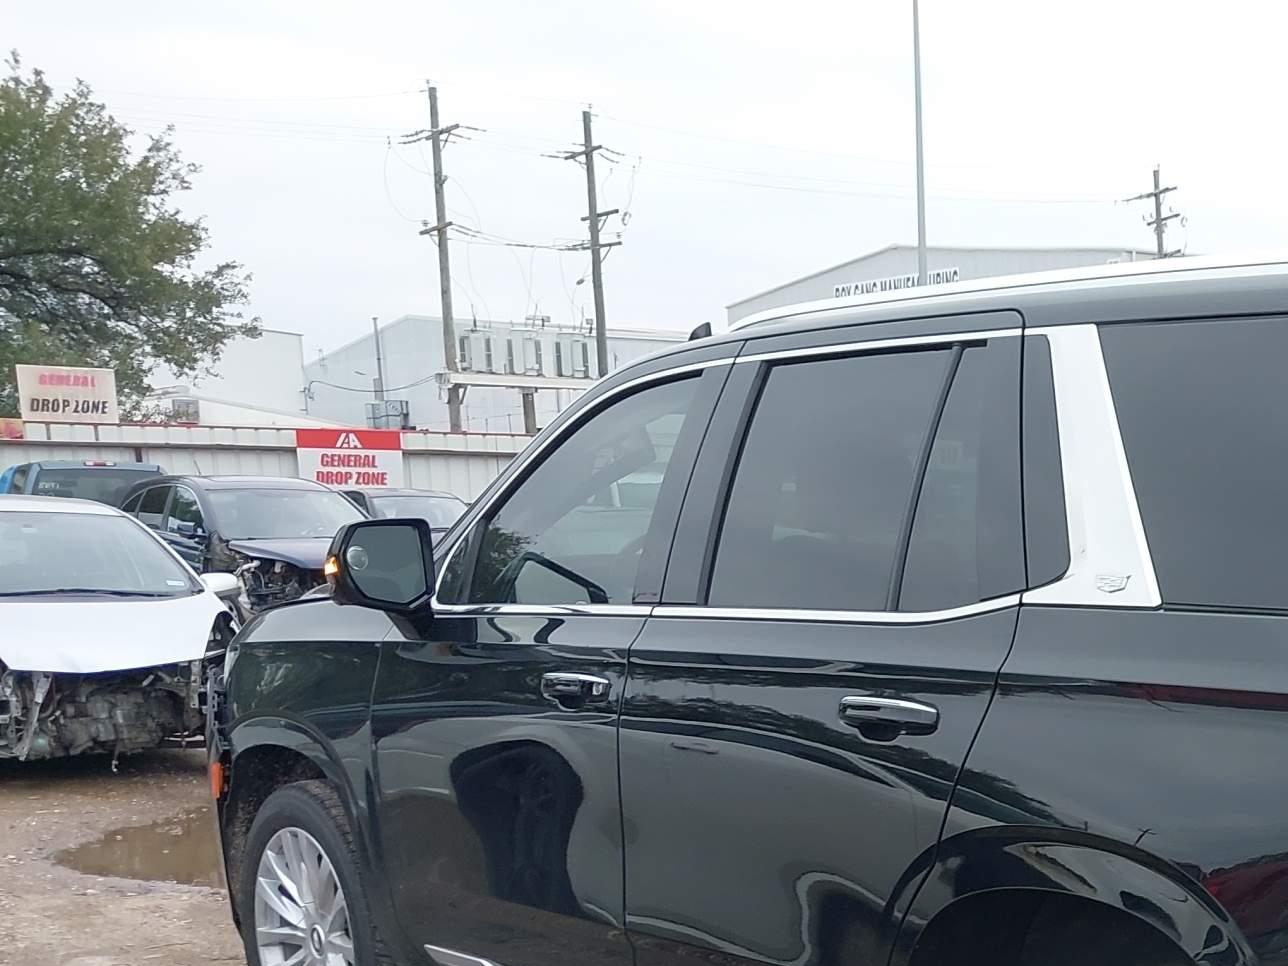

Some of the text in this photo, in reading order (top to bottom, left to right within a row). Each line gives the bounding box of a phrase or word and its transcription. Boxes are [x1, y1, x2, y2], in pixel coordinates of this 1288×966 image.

[38, 373, 96, 387] GENERAL
[30, 398, 70, 413] DROP
[320, 453, 378, 468] GENERAL
[316, 471, 388, 485] DROP ZONE
